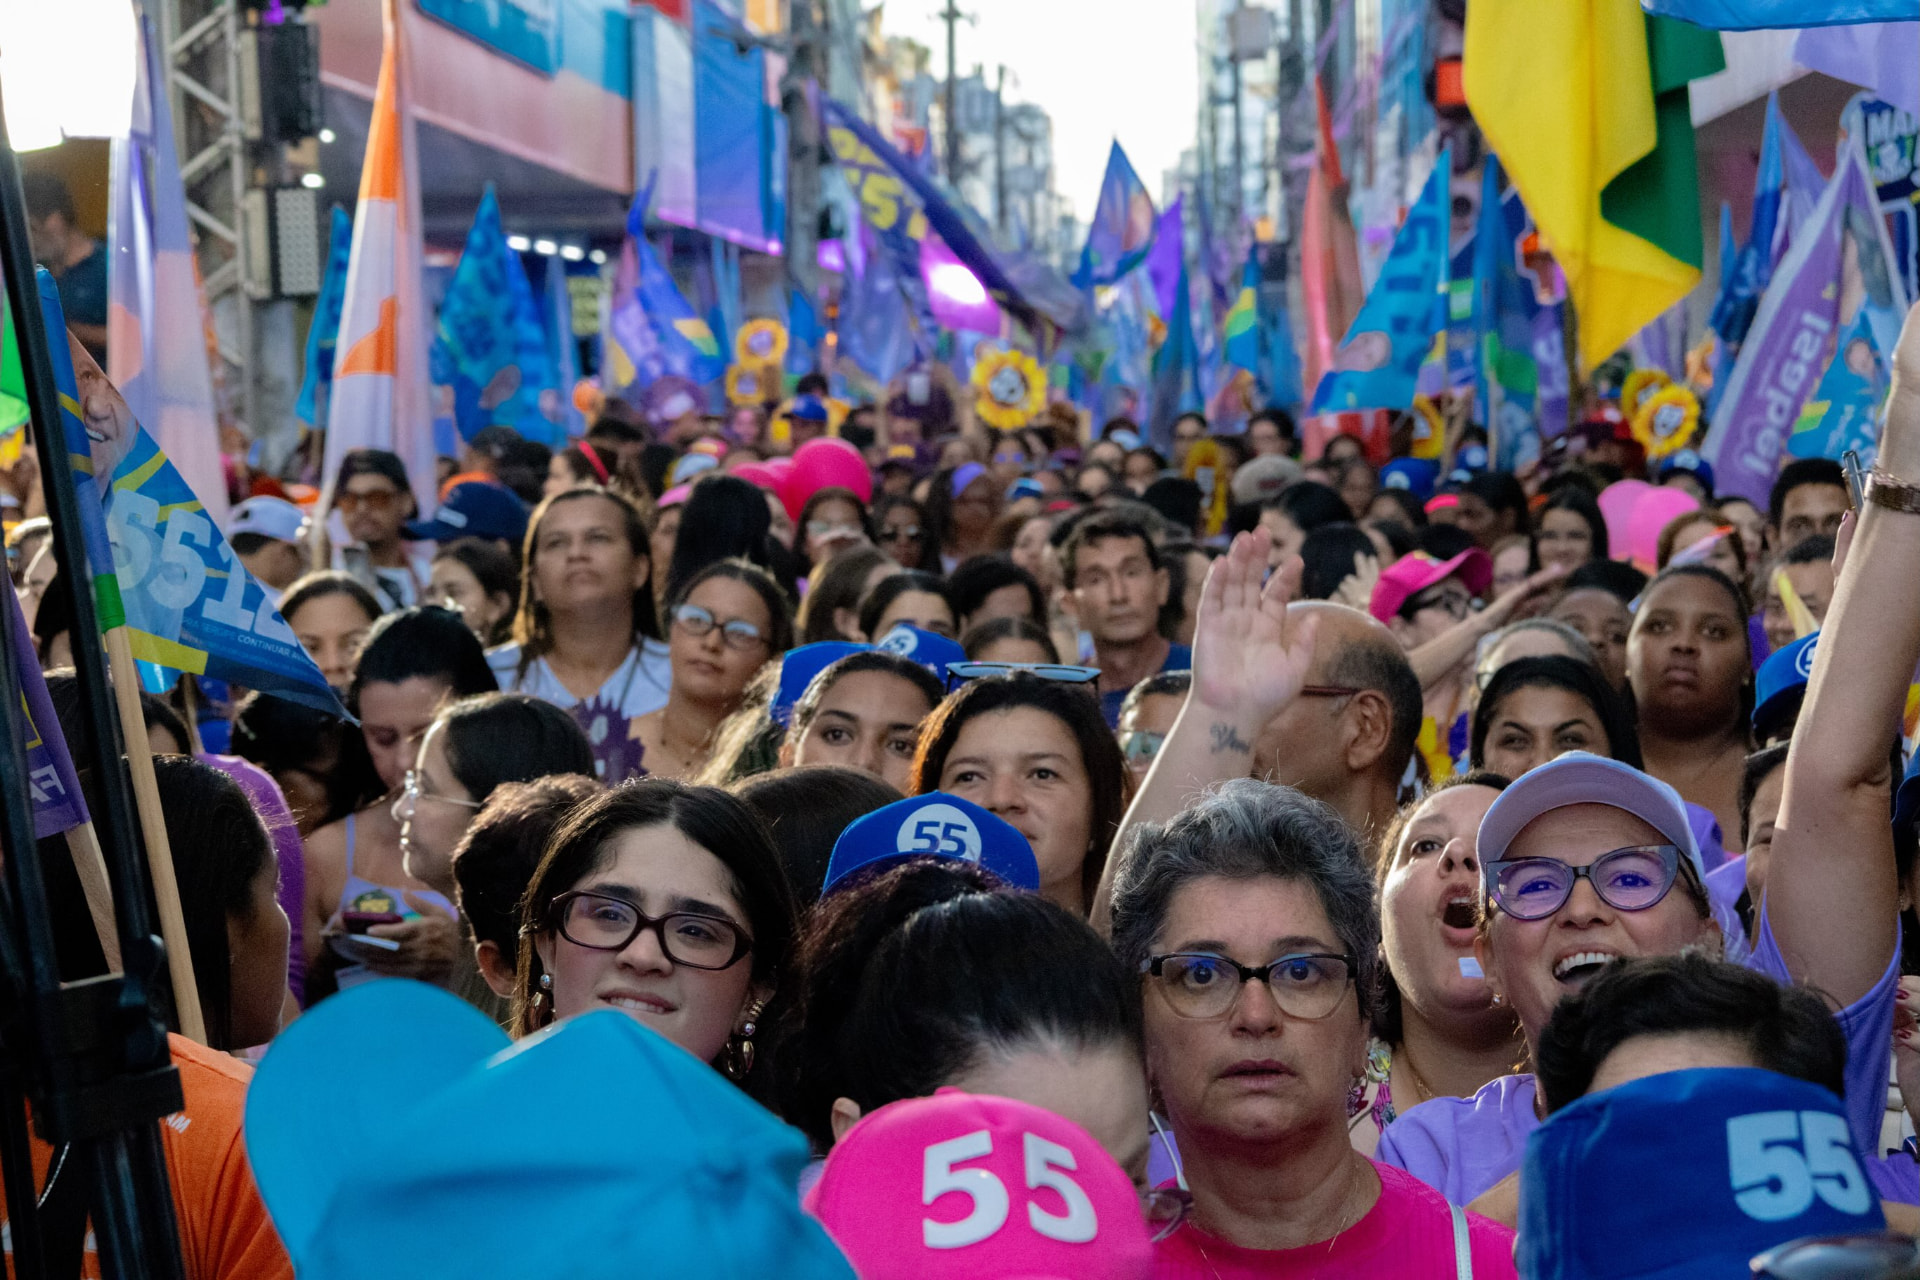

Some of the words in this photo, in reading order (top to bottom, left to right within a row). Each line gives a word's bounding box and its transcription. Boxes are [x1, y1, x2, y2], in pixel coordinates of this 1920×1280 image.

[236, 634, 290, 656] CONTINUAR
[911, 820, 969, 858] 55
[921, 1129, 1099, 1249] 55
[1725, 1109, 1872, 1223] 55
